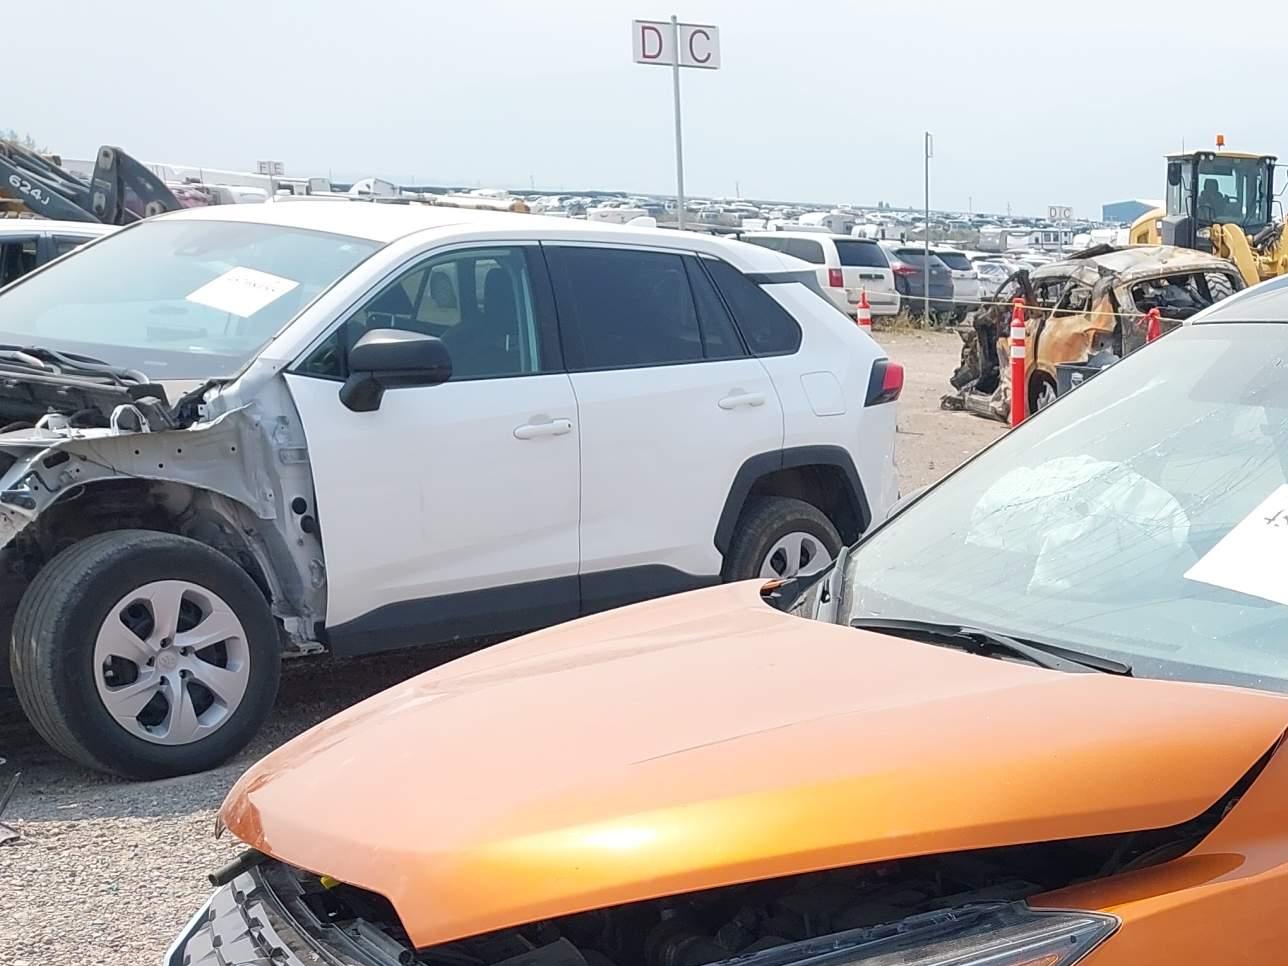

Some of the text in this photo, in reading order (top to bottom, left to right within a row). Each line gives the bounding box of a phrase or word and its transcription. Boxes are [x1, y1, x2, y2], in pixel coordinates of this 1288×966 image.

[641, 26, 711, 64] D C
[8, 174, 50, 205] 624J
